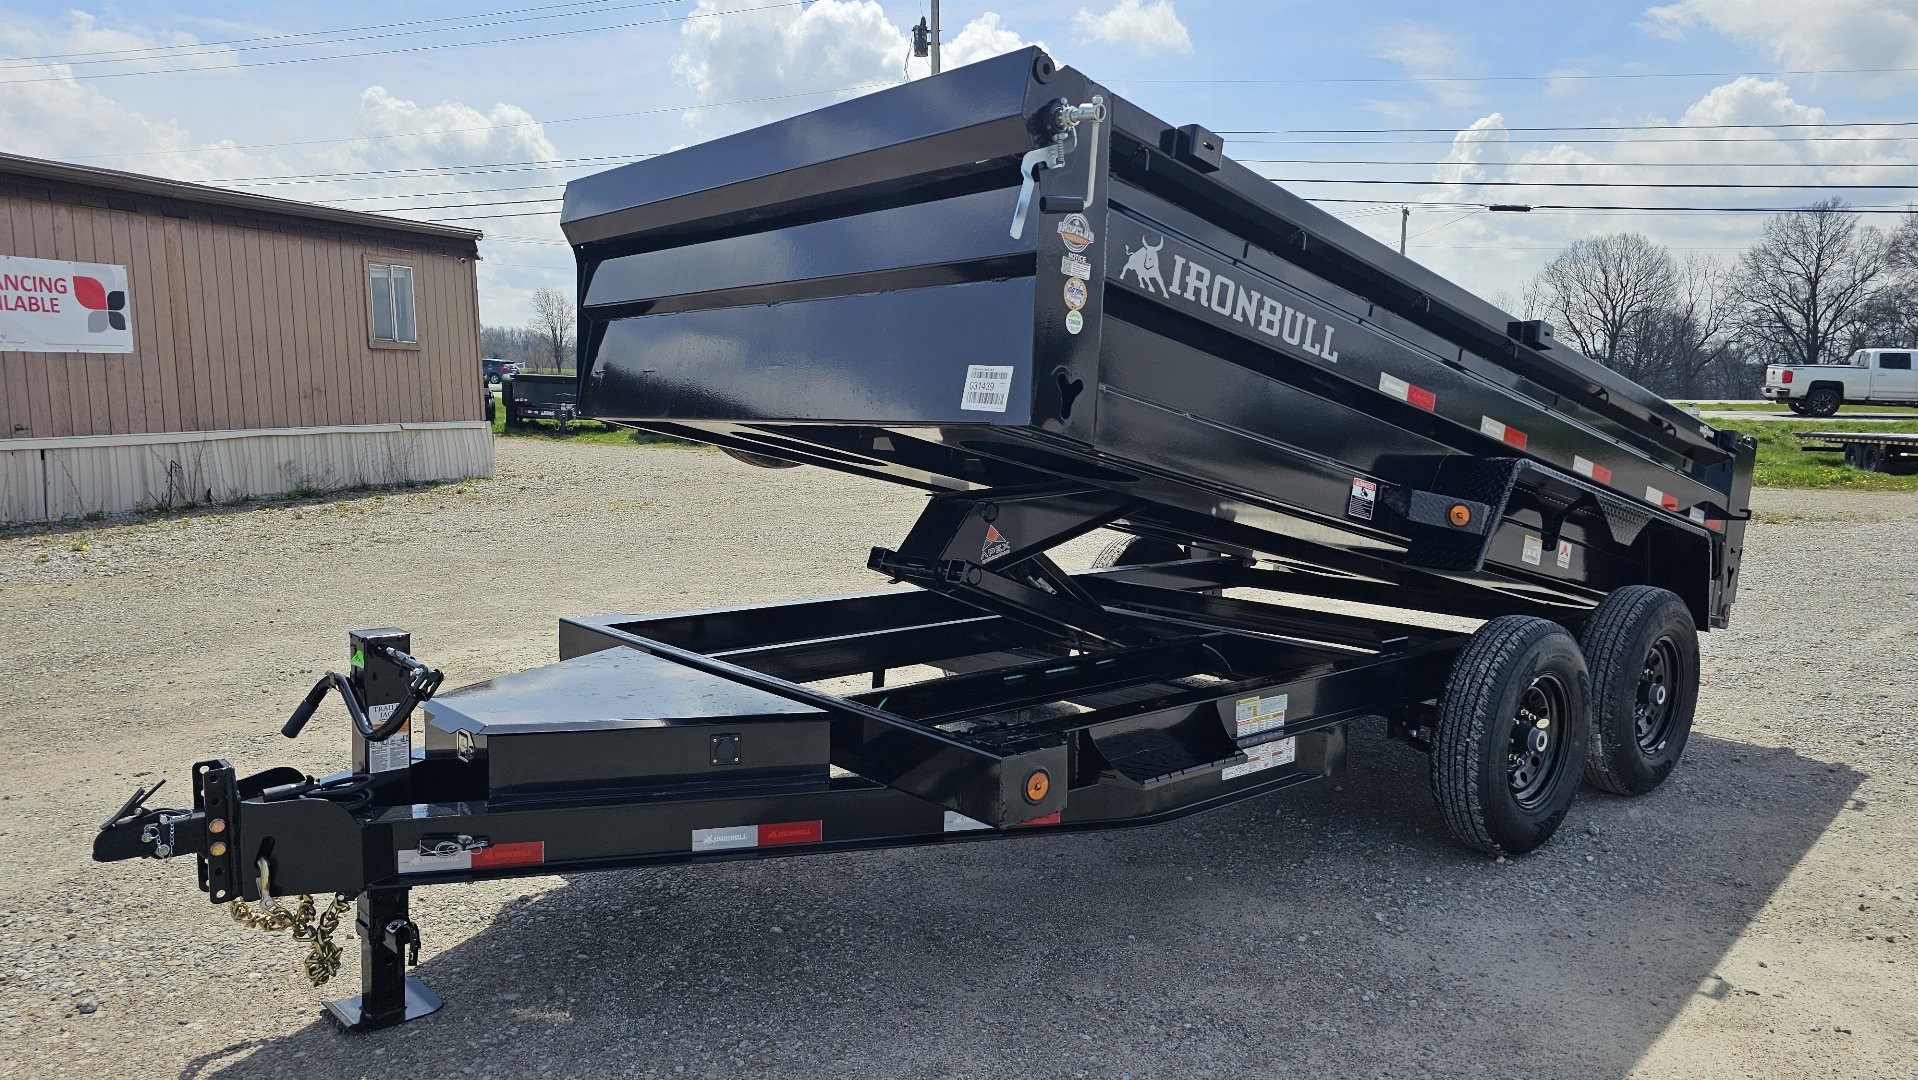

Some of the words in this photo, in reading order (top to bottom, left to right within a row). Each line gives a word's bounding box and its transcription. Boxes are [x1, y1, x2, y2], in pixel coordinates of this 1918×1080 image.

[1068, 251, 1087, 263] NOTICE
[1169, 254, 1338, 363] IRONBULL
[980, 541, 1011, 560] APEX
[714, 832, 748, 842] IRONBULL
